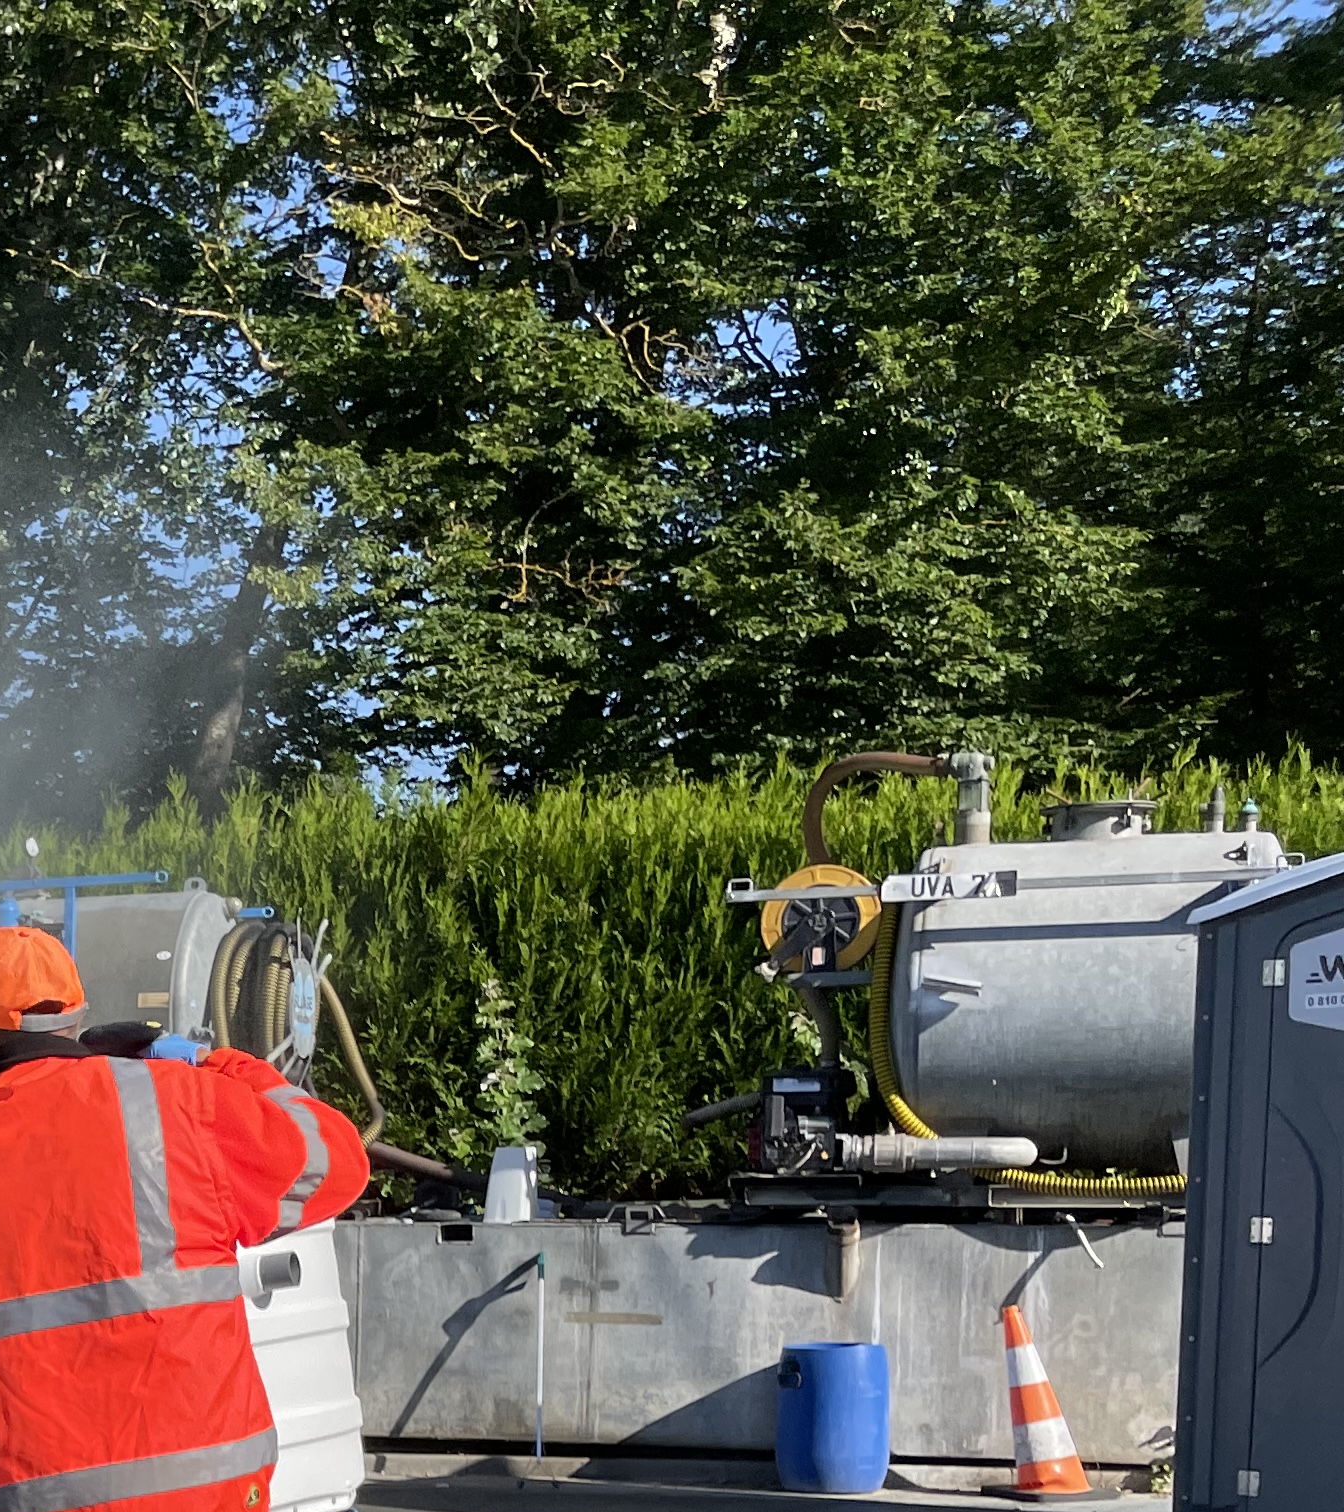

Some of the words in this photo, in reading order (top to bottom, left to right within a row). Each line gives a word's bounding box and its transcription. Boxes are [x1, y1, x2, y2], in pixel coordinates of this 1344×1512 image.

[912, 875, 954, 897] UVA
[1307, 996, 1315, 1007] 0
[1317, 995, 1338, 1006] 810
